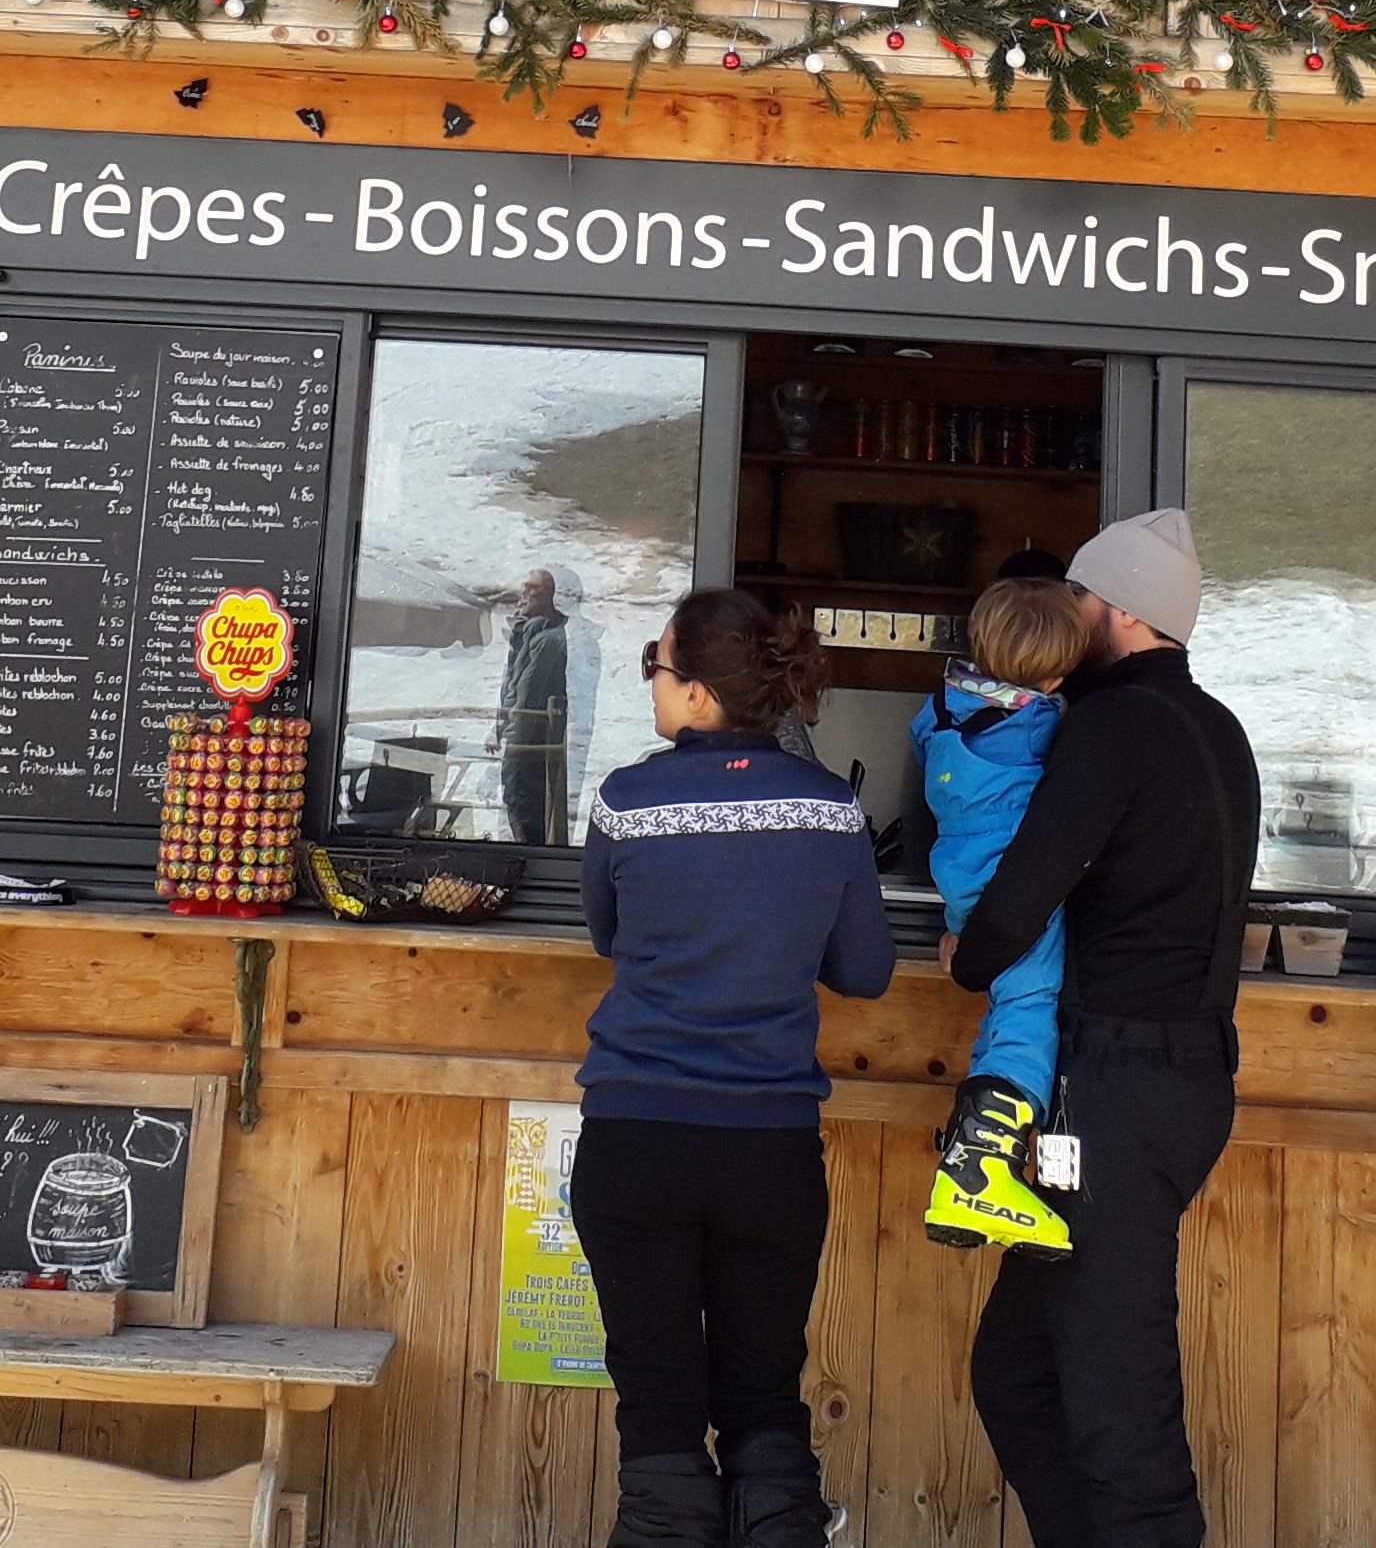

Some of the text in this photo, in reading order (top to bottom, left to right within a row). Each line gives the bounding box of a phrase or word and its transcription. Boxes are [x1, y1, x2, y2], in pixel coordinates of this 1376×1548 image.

[355, 177, 727, 270] Boissons
[781, 198, 1250, 299] Sandwichs
[212, 615, 279, 645] Chupa
[207, 641, 274, 681] Chups
[952, 1192, 1036, 1228] HEAD
